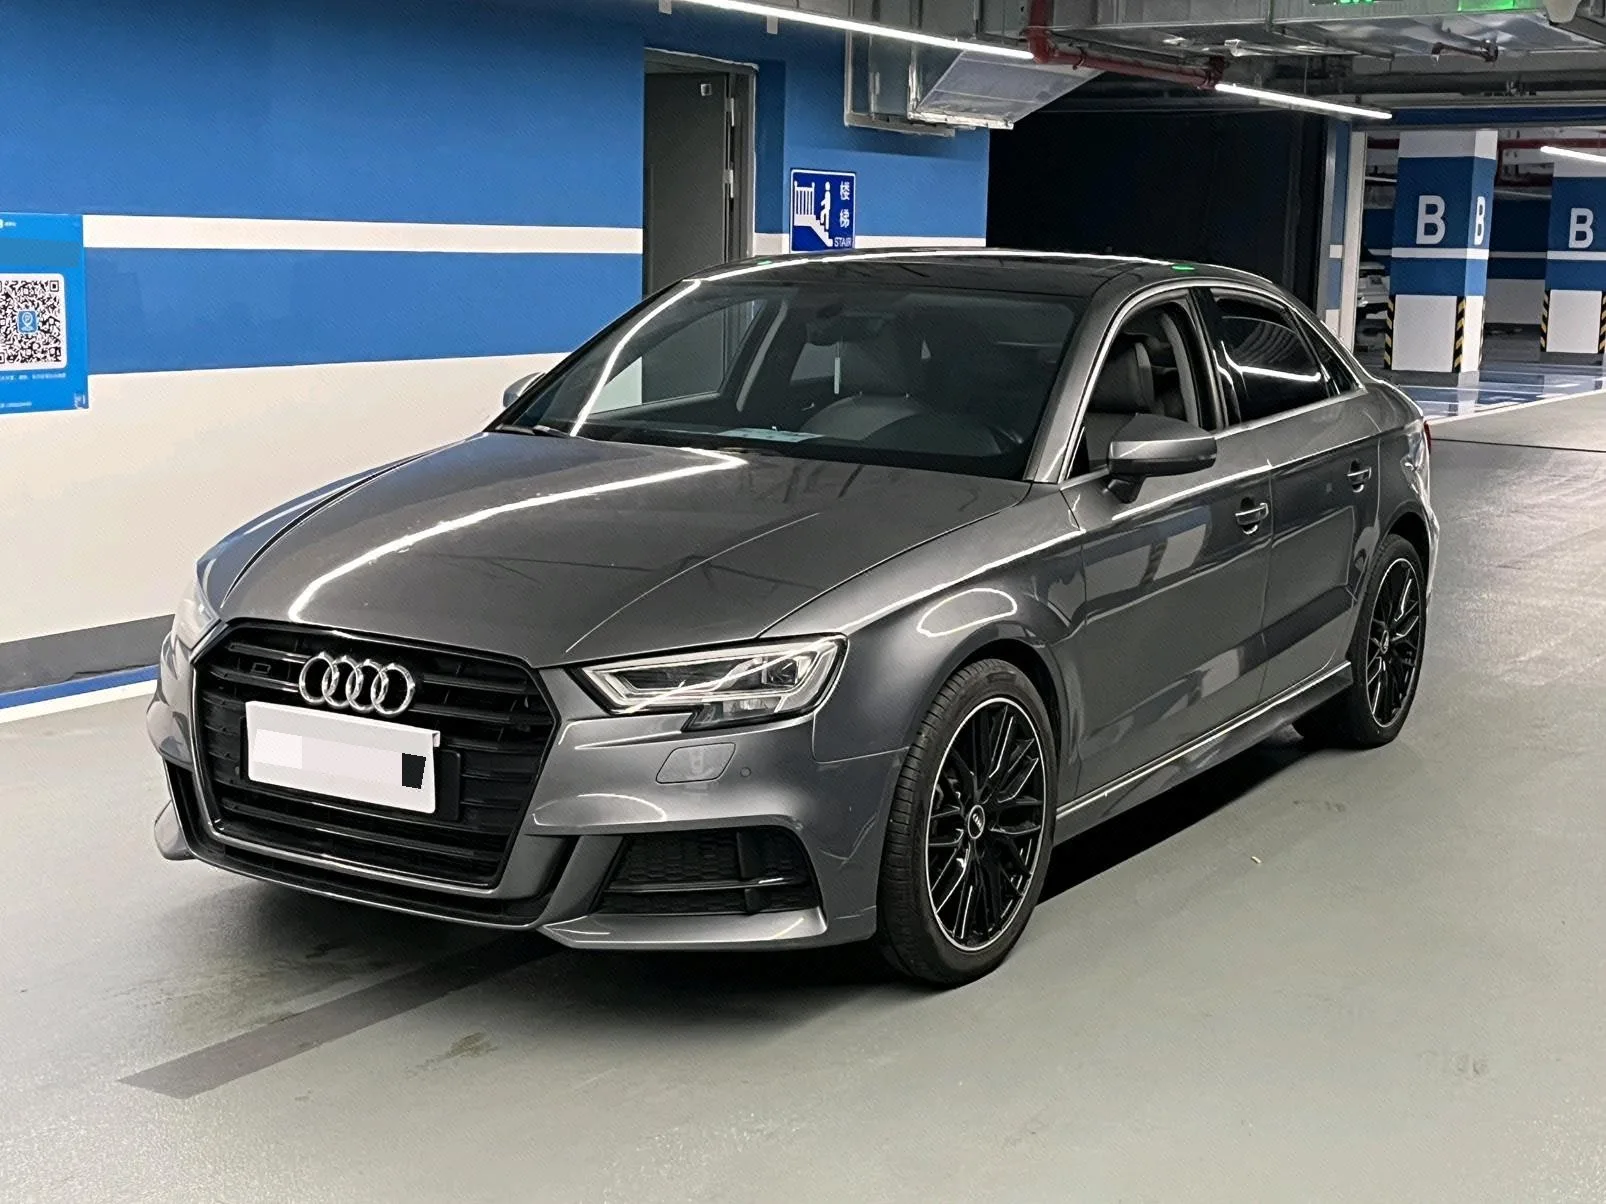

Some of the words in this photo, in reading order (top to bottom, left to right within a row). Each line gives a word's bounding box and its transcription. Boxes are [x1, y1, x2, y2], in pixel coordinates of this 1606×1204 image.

[839, 181, 850, 228] 楼梯
[1416, 195, 1446, 245] B
[1474, 196, 1486, 245] B
[1568, 207, 1594, 249] B
[834, 237, 852, 247] STAIR
